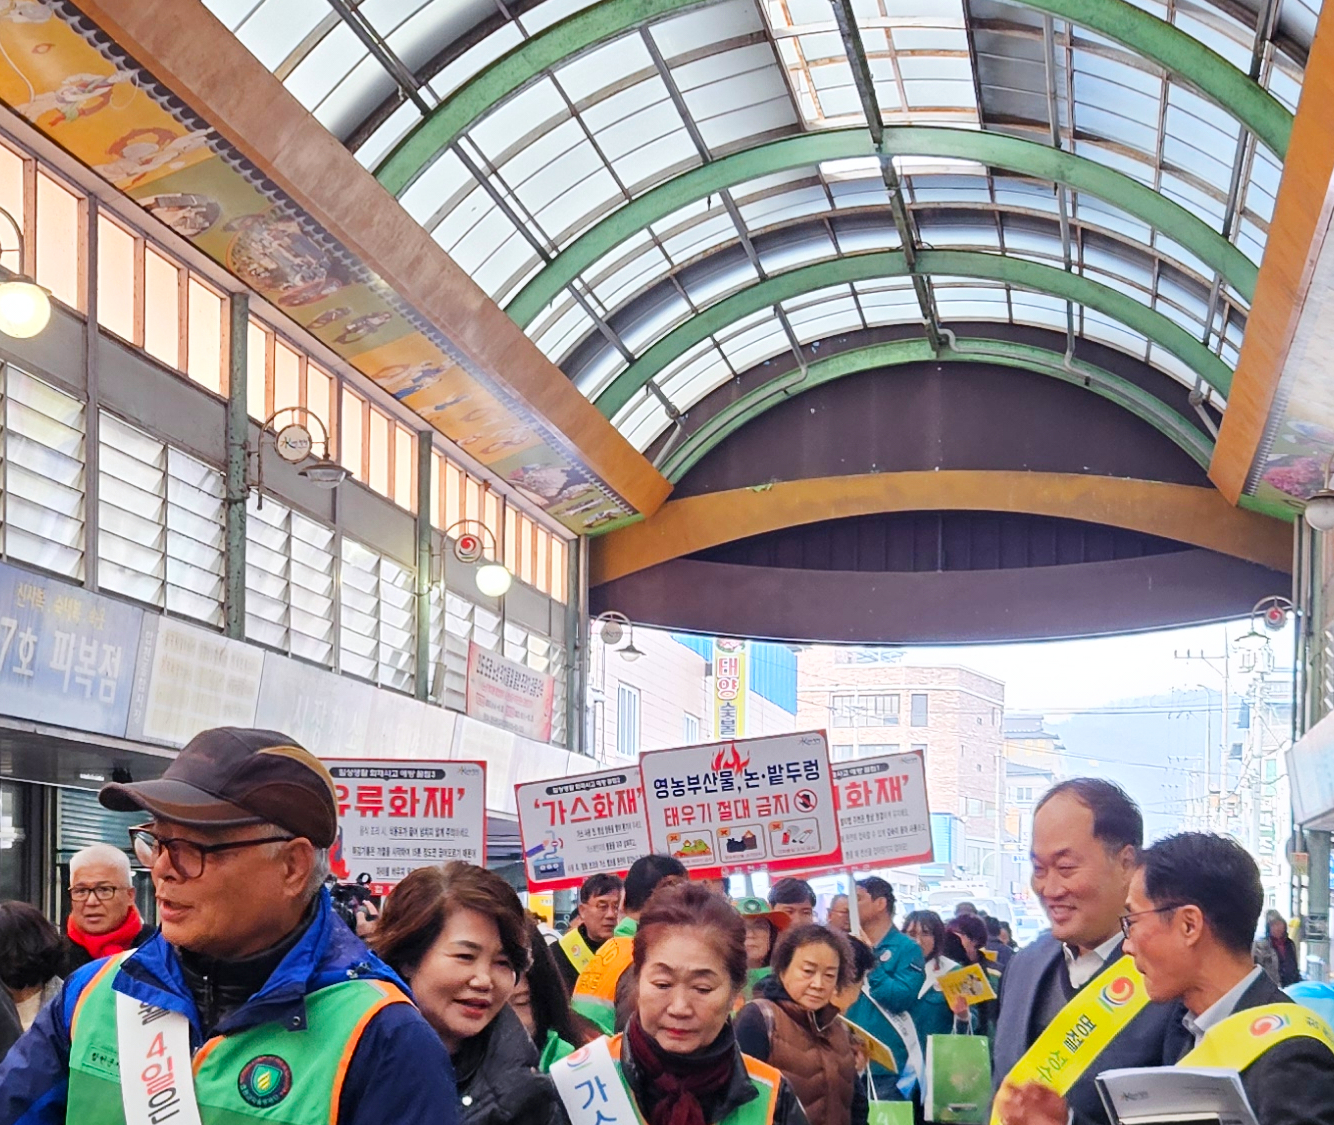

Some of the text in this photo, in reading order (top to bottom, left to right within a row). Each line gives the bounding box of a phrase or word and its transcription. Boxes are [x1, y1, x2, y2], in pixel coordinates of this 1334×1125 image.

[50, 629, 123, 703] 피복점
[717, 657, 739, 699] 태양
[653, 769, 743, 800] 영농부산물,
[663, 794, 790, 827] 태우기 절대 금지
